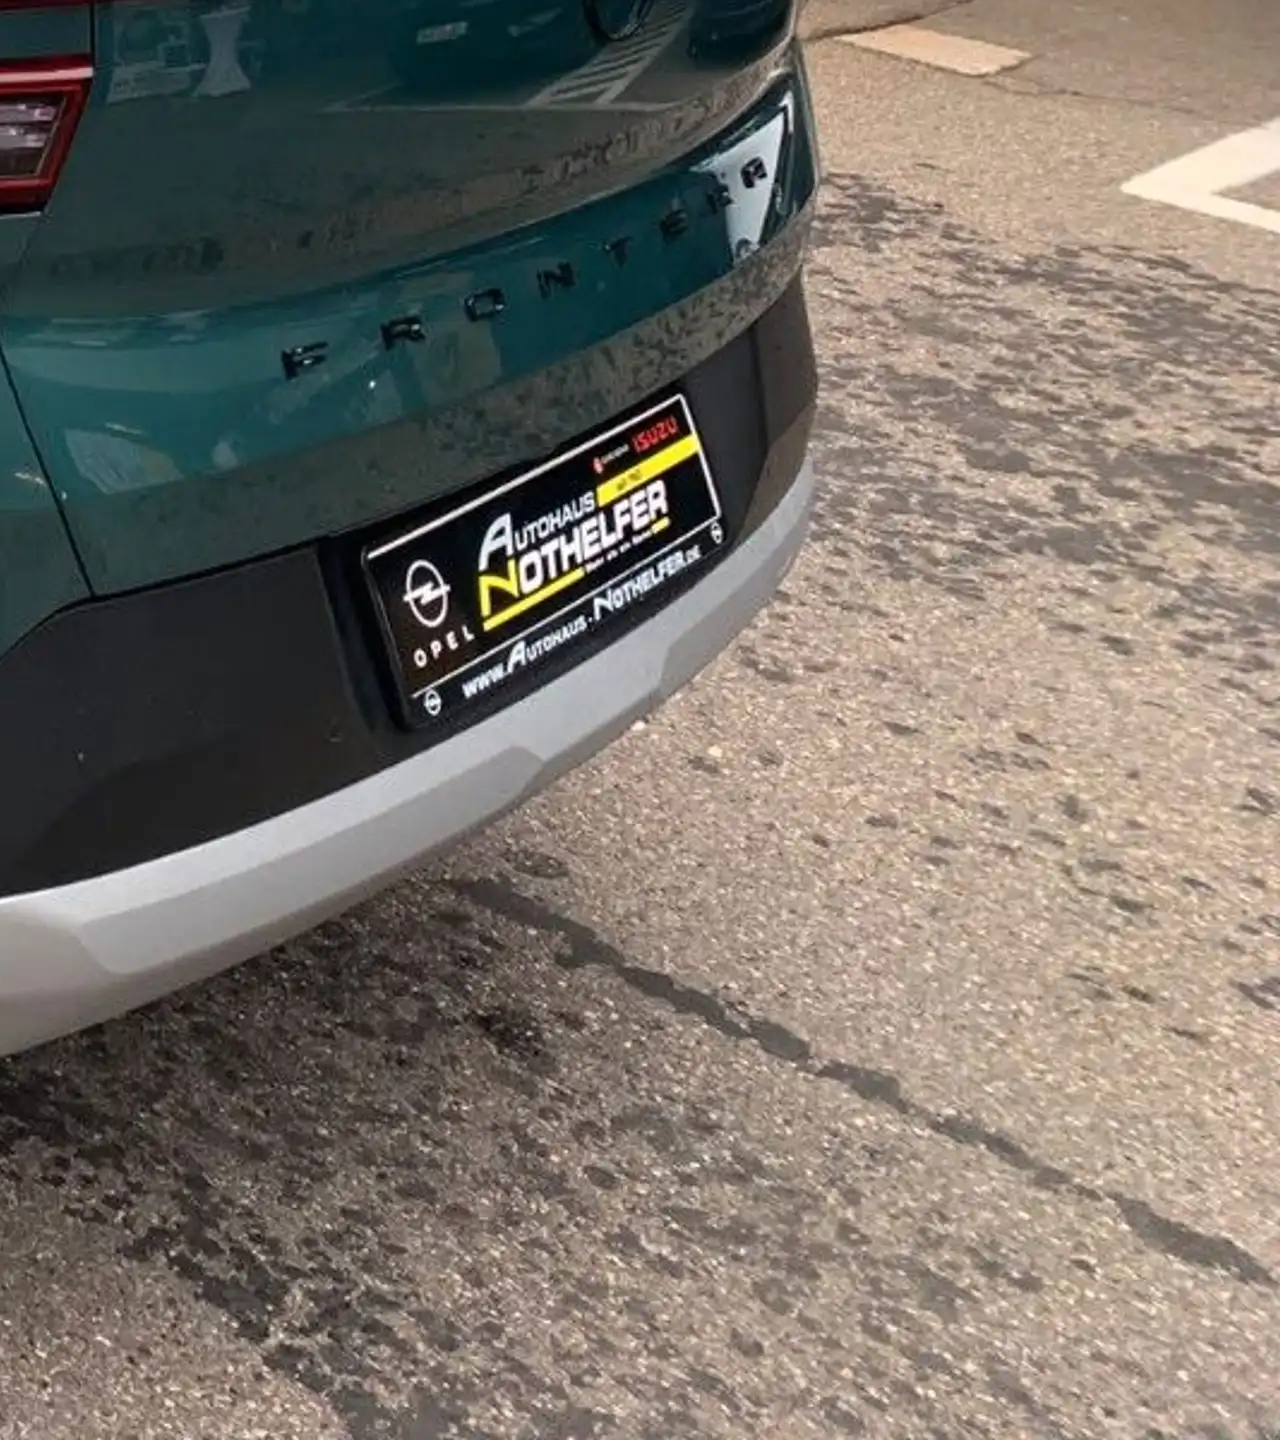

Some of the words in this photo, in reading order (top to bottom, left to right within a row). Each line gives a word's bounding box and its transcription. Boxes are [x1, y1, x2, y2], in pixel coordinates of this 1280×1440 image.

[281, 156, 766, 380] FRONTERA
[632, 415, 679, 454] ISUZU
[478, 491, 596, 571] AUTOHAUS
[478, 479, 669, 618] NOTHELFER
[413, 624, 475, 668] OPEL
